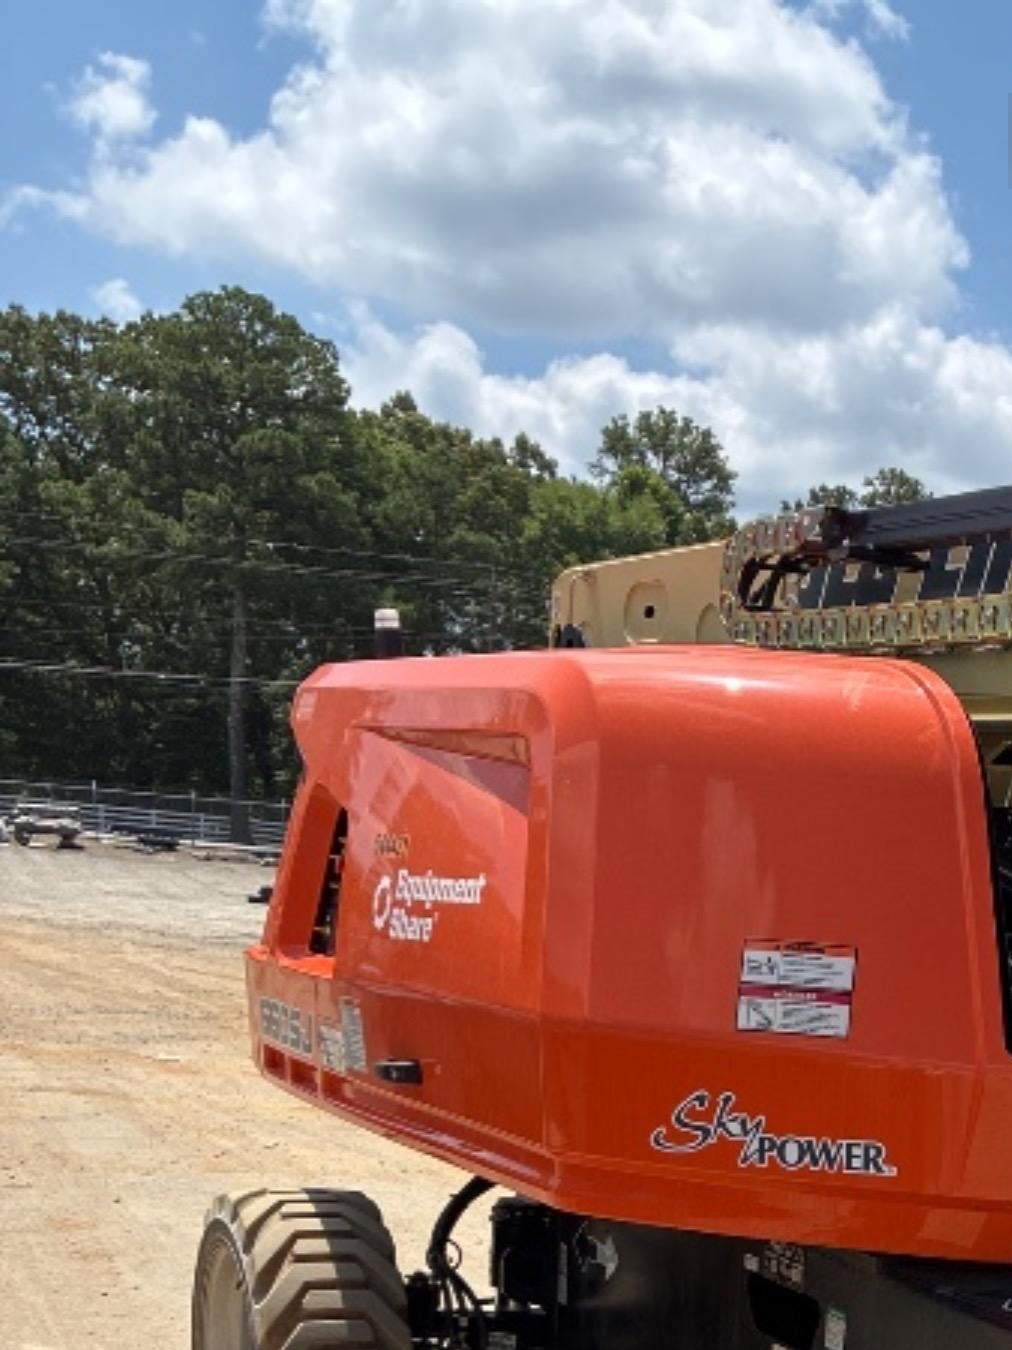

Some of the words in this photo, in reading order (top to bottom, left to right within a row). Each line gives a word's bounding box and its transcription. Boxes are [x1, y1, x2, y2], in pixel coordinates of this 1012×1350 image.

[394, 868, 487, 909] Equipment
[388, 907, 434, 943] Share
[651, 1089, 765, 1168] Sky
